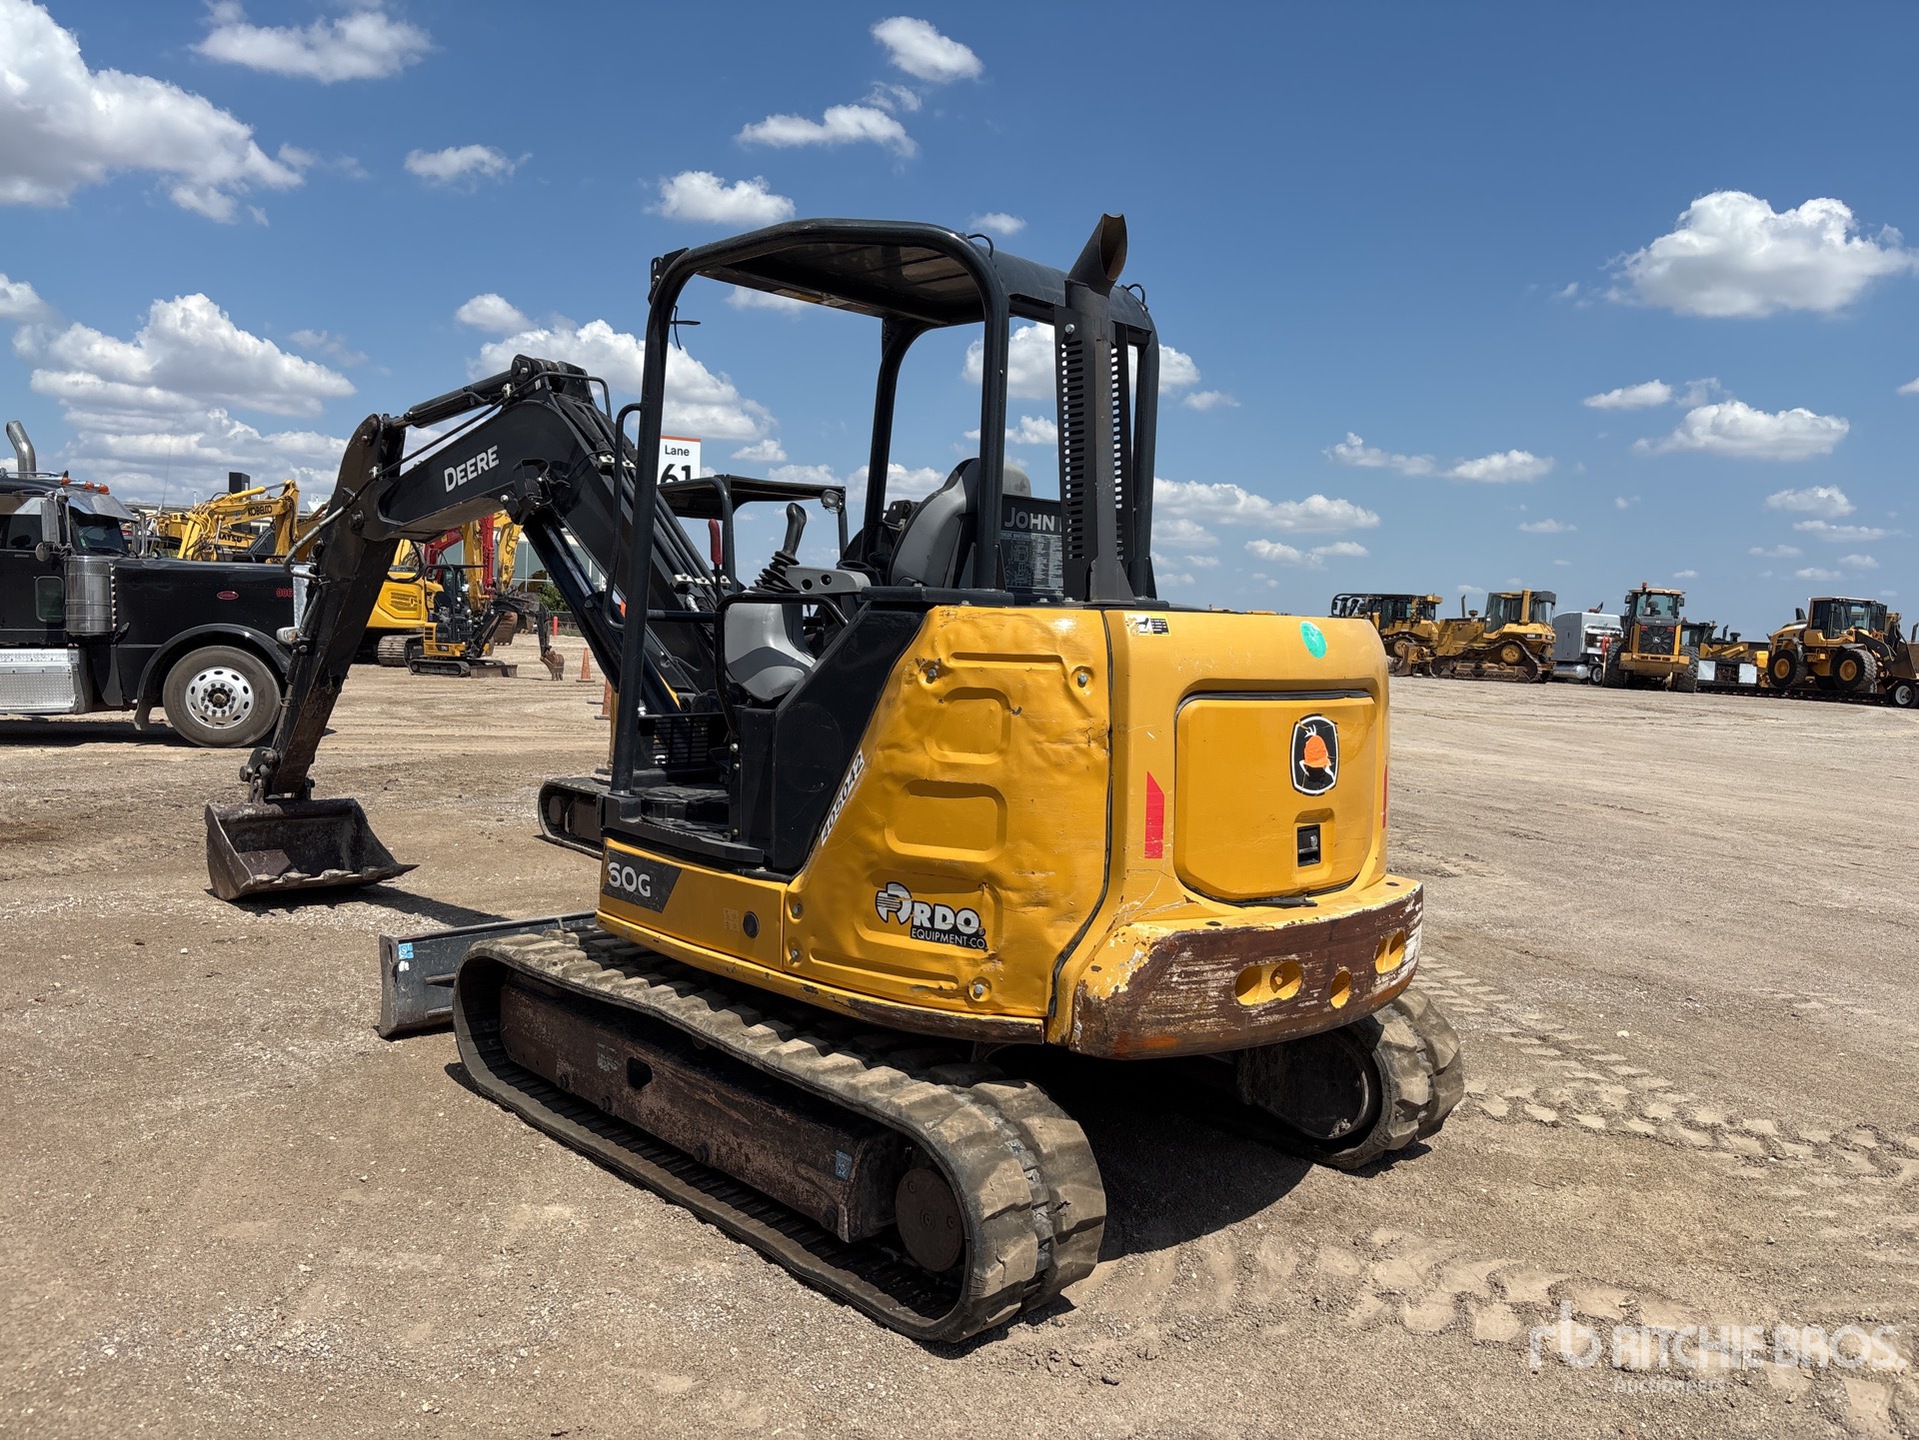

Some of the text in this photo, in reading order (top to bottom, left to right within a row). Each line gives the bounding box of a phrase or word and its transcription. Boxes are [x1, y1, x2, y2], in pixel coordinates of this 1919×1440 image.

[665, 444, 690, 457] Lane
[443, 445, 500, 493] DEERE
[660, 463, 692, 484] 61
[247, 504, 273, 517] KOBELCO
[1004, 507, 1055, 532] JOHN
[912, 900, 981, 936] RDO
[910, 927, 968, 946] EQUIPMENT
